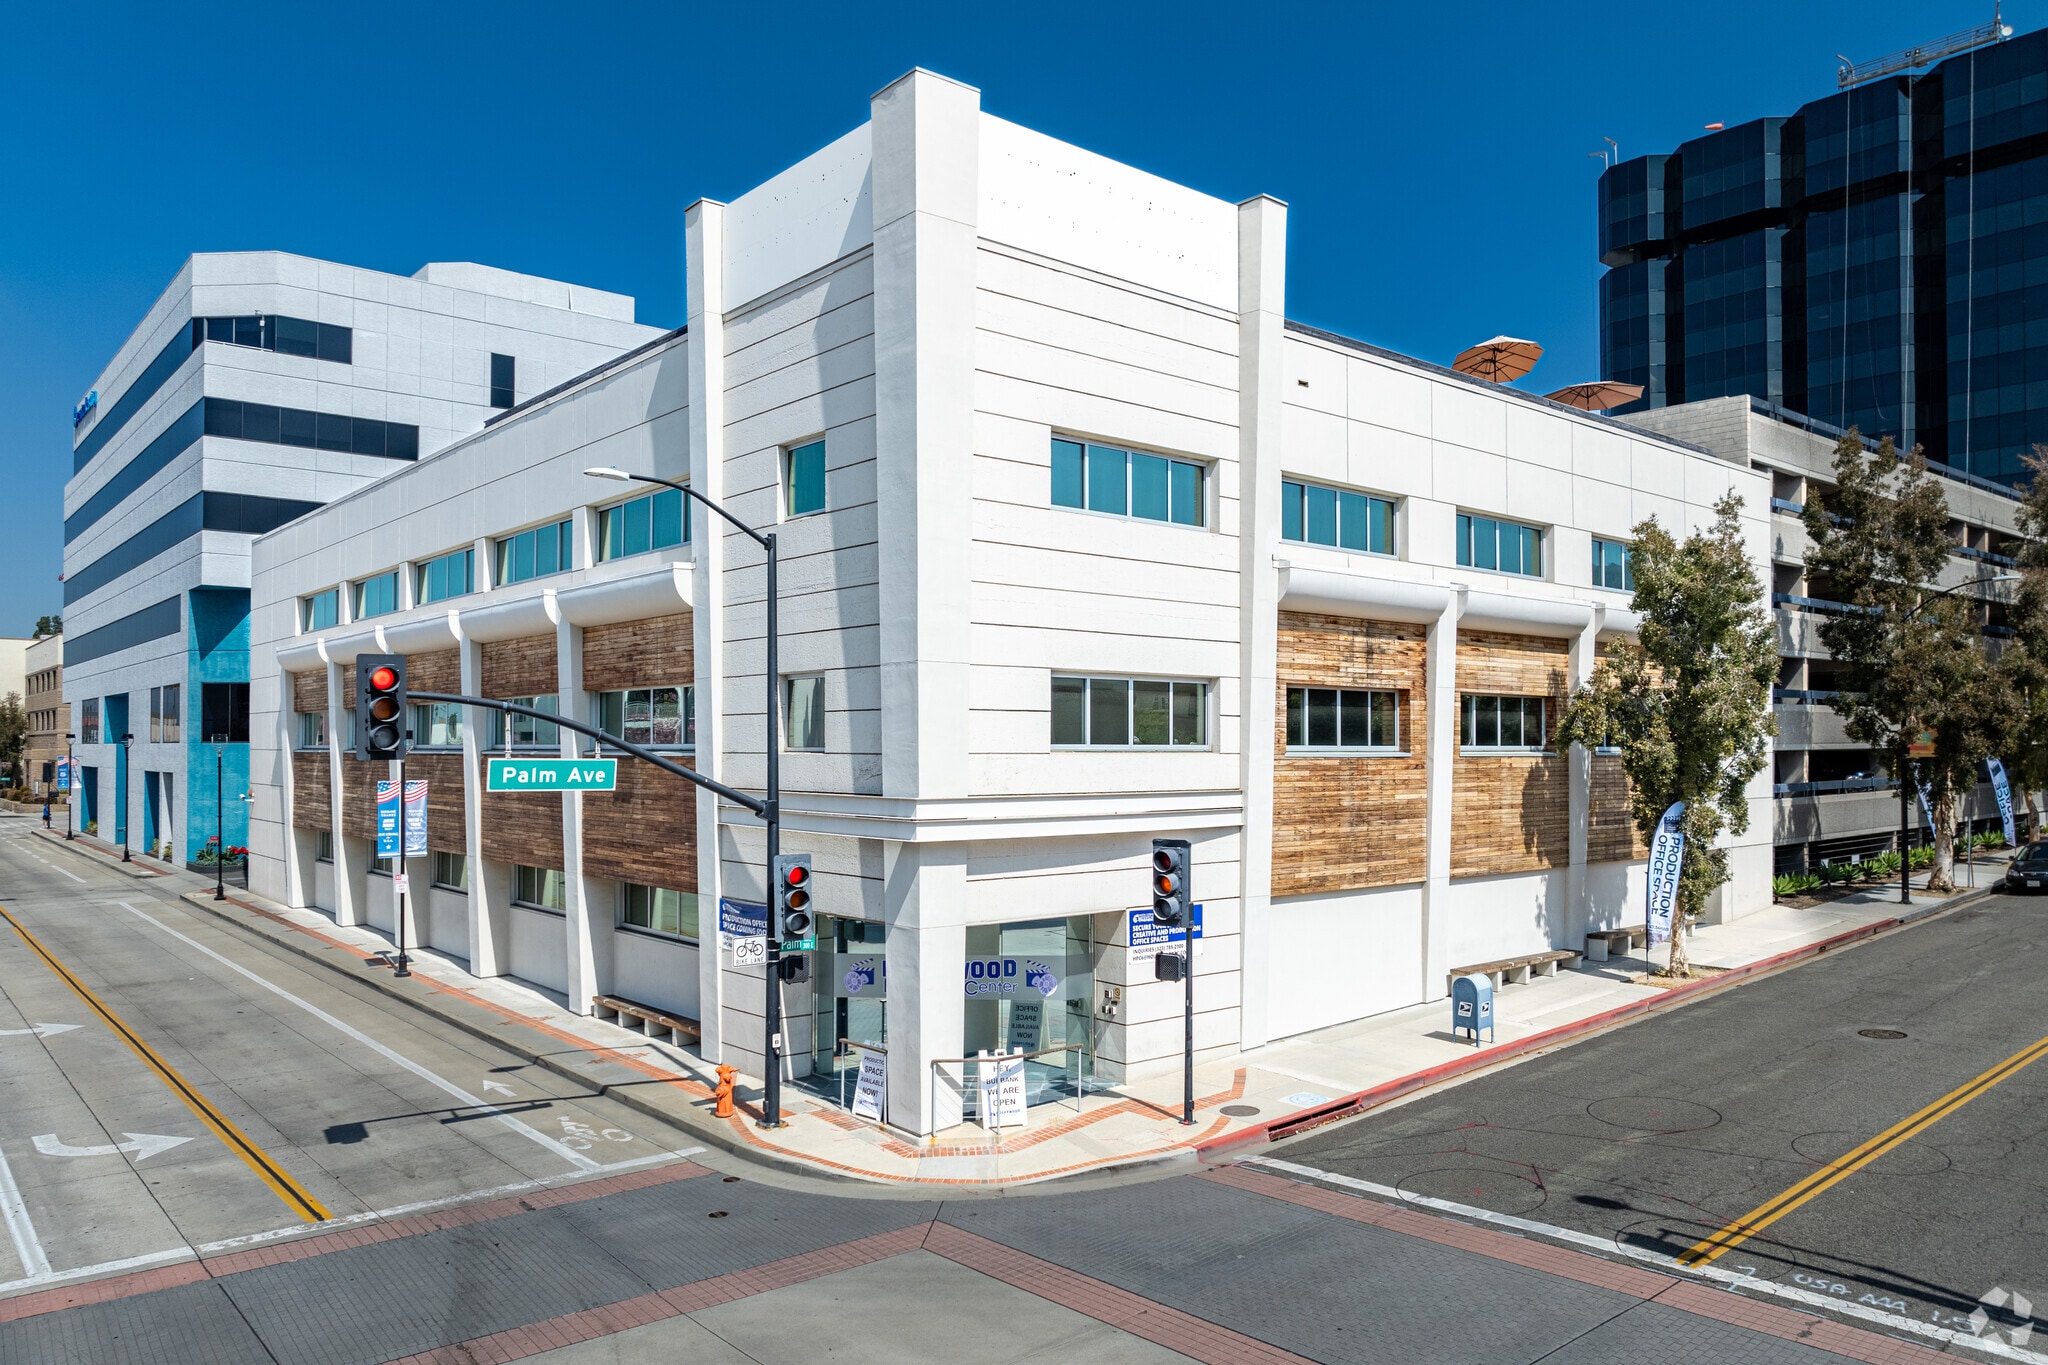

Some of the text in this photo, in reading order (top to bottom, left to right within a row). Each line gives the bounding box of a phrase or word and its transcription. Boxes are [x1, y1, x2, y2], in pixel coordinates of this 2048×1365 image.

[502, 766, 606, 783] Palm Ave
[1653, 835, 1668, 876] OFFICE
[1660, 837, 1680, 918] PRODUCTION
[1651, 877, 1661, 915] SPACE
[722, 913, 767, 928] PRODUCTION OFFIC
[755, 928, 767, 936] SOO
[1132, 924, 1152, 932] SECURE
[1132, 929, 1157, 938] CREATIVE
[1150, 935, 1169, 943] SPACES
[781, 940, 801, 950] Palm
[965, 981, 1018, 996] Center
[865, 1066, 884, 1076] SPACE
[861, 1076, 884, 1087] AVAILABLE
